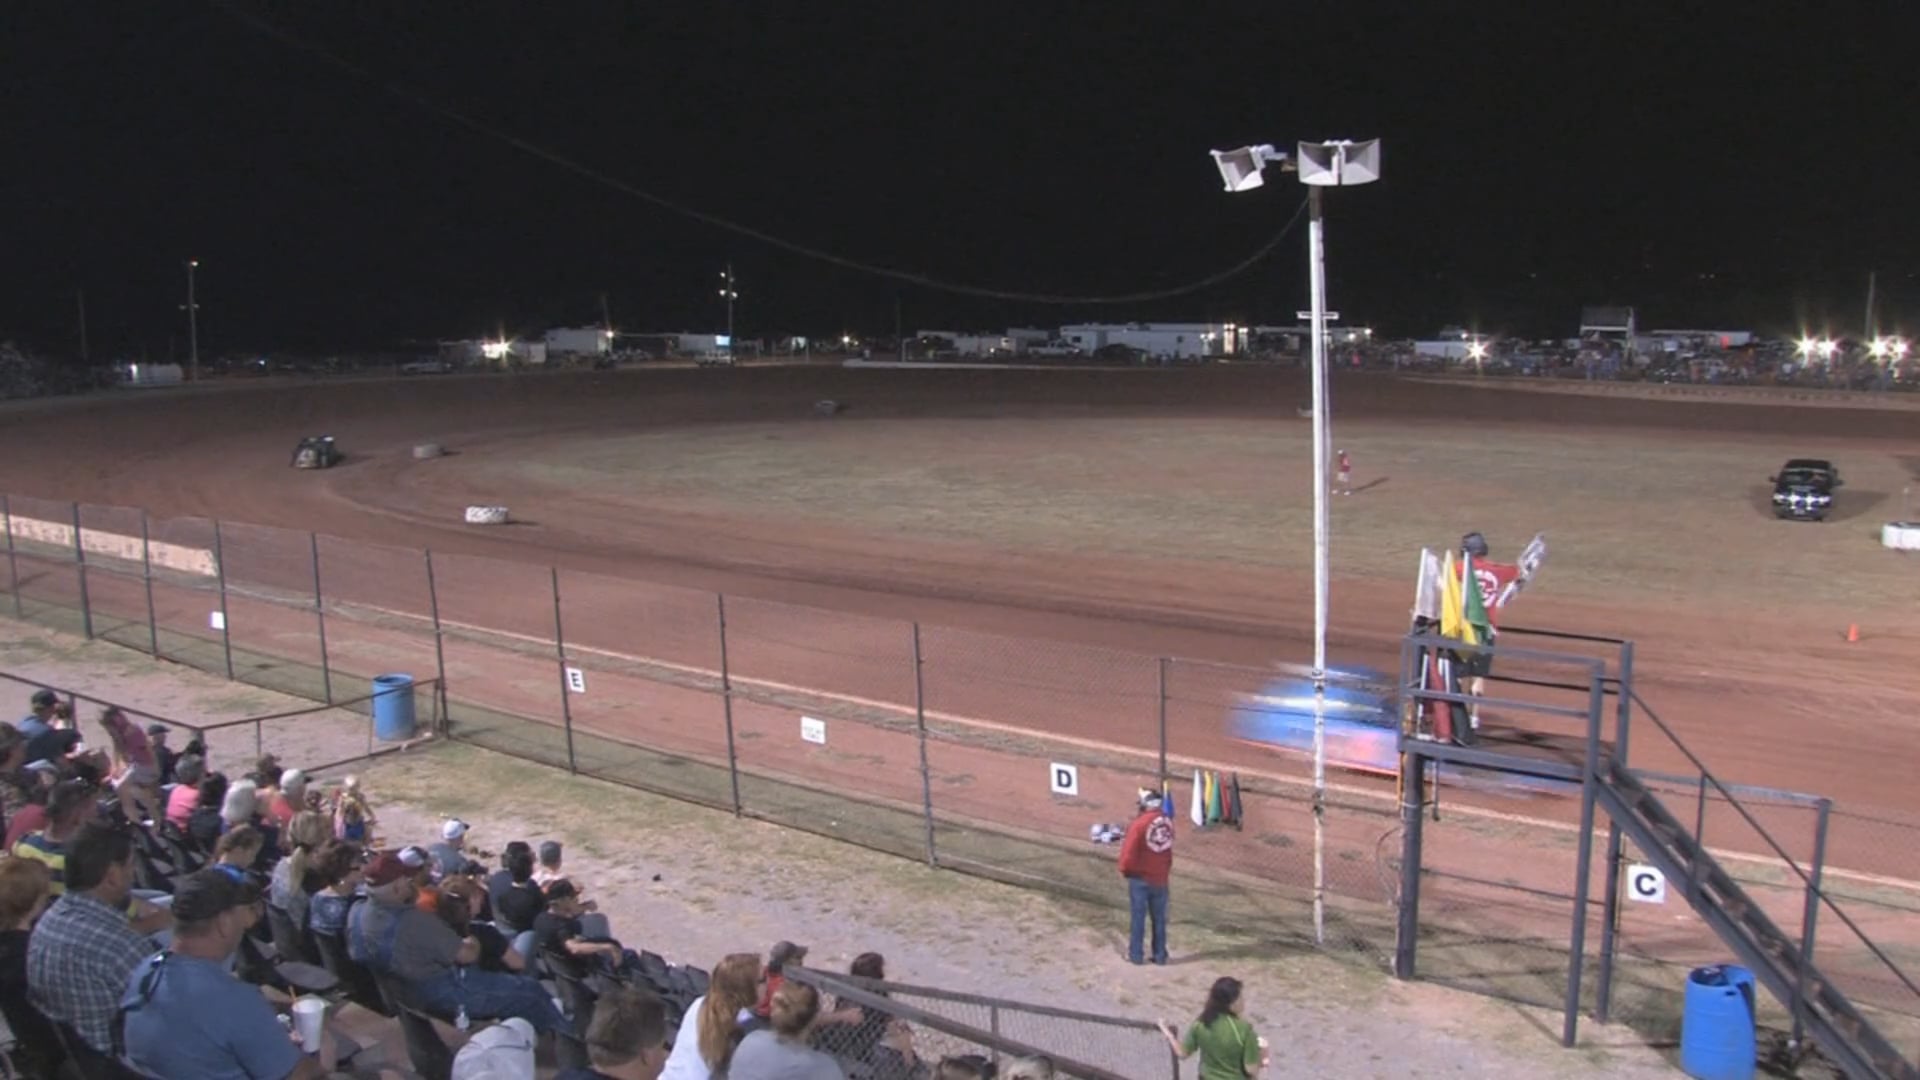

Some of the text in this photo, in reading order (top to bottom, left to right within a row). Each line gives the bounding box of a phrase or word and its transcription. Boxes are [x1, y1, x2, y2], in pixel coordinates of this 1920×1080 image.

[570, 672, 582, 688] E
[1056, 769, 1072, 788] D
[1635, 873, 1657, 896] C
